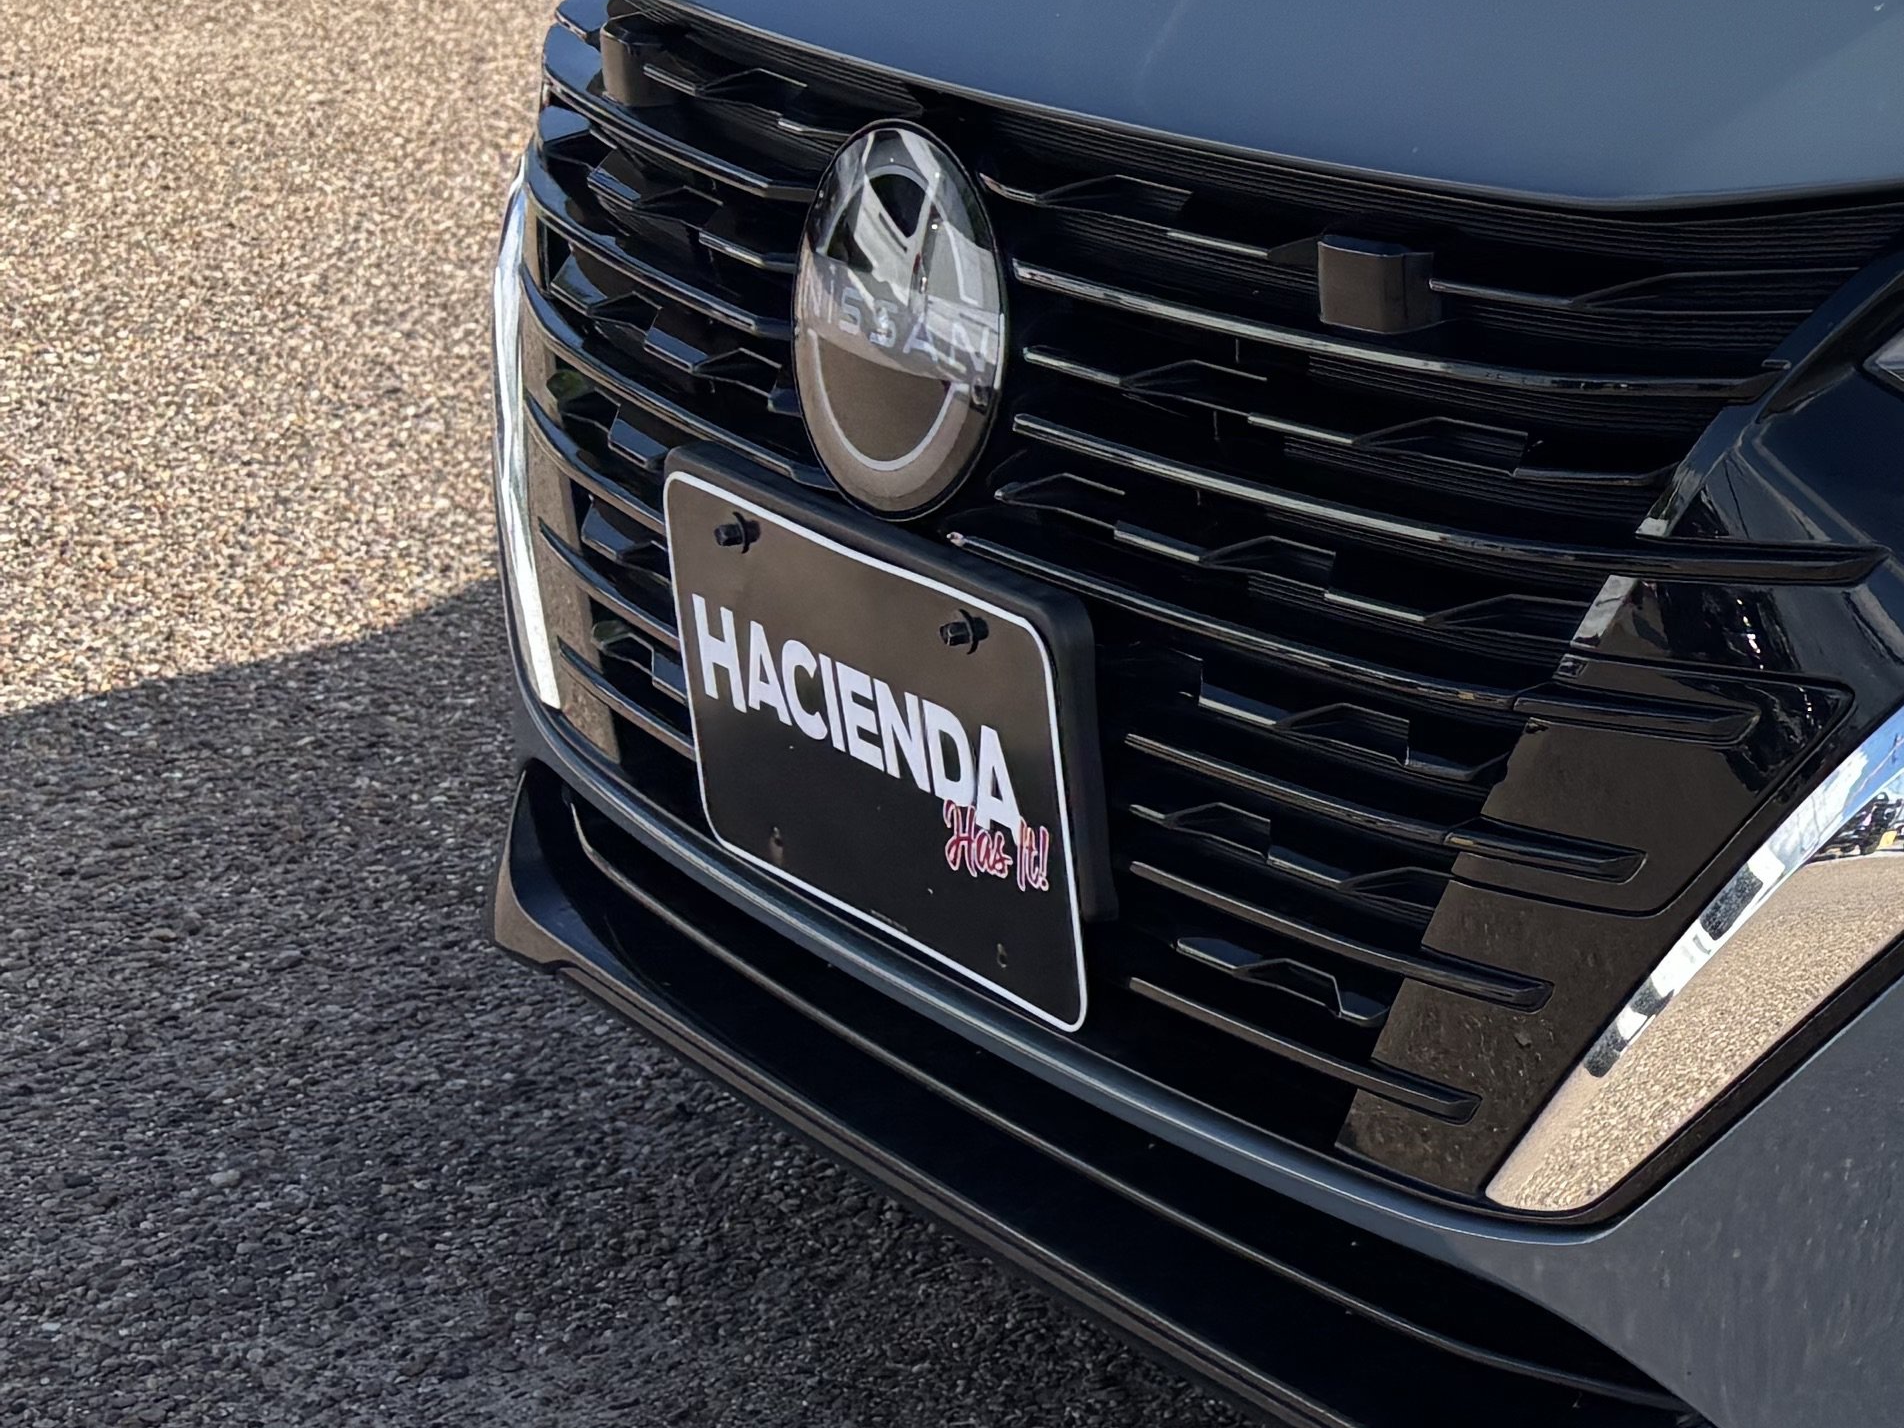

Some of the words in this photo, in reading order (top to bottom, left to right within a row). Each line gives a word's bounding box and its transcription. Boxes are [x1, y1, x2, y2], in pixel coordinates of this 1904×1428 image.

[797, 262, 992, 374] NISSAN
[692, 593, 1022, 847] HACIENDA
[942, 799, 1013, 879] Has
[1015, 815, 1050, 892] It!
